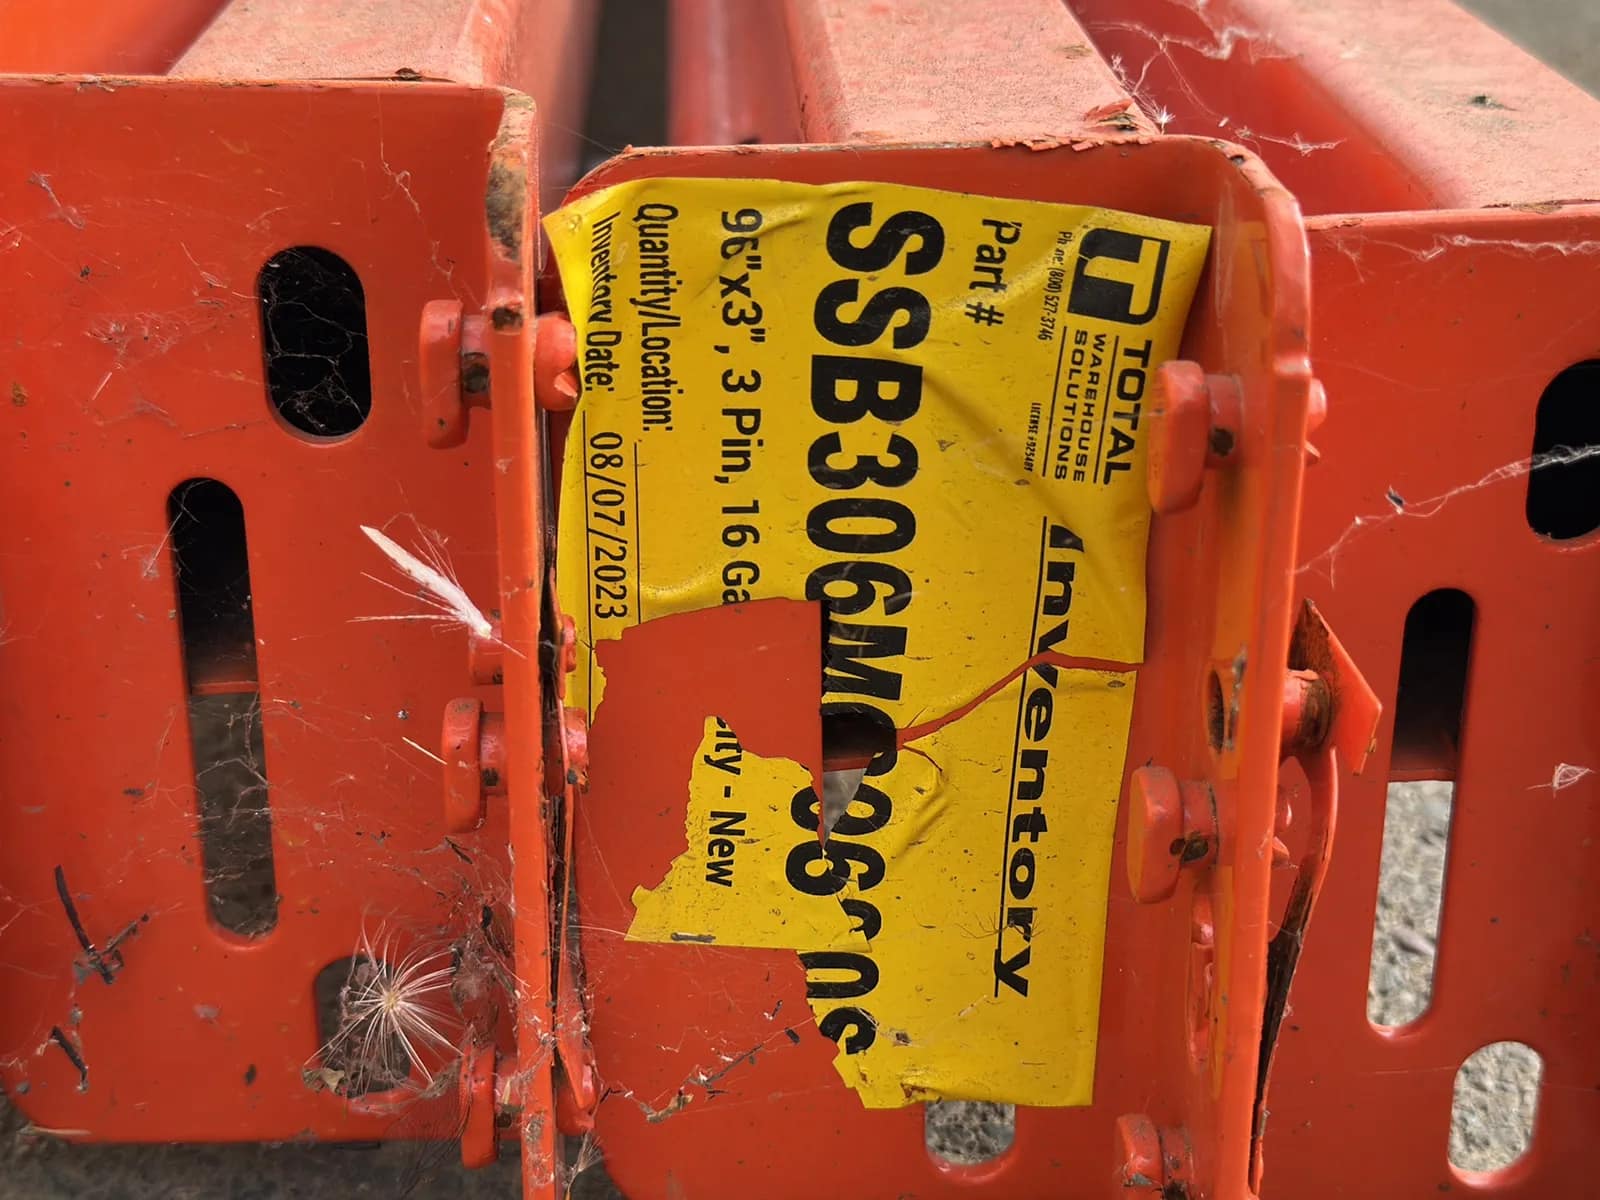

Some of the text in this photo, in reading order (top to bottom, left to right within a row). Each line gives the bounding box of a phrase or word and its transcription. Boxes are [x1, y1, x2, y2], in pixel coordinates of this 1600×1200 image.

[630, 203, 684, 432] Quantity/Location:
[964, 218, 1022, 327] Part #
[1037, 231, 1073, 341] Phne: (800) 527-3746
[585, 211, 629, 619] Inventory Date: 08/07/2023
[720, 368, 762, 393] 3
[1027, 402, 1042, 434] LICENSE
[1055, 329, 1087, 480] SOLUTIONS
[1073, 333, 1106, 482] WAREHOUSE
[1103, 339, 1152, 485] TOTAL
[713, 408, 763, 484] Pin,
[720, 500, 760, 548] 16
[994, 525, 1085, 998] Inventory
[705, 811, 747, 888] New
